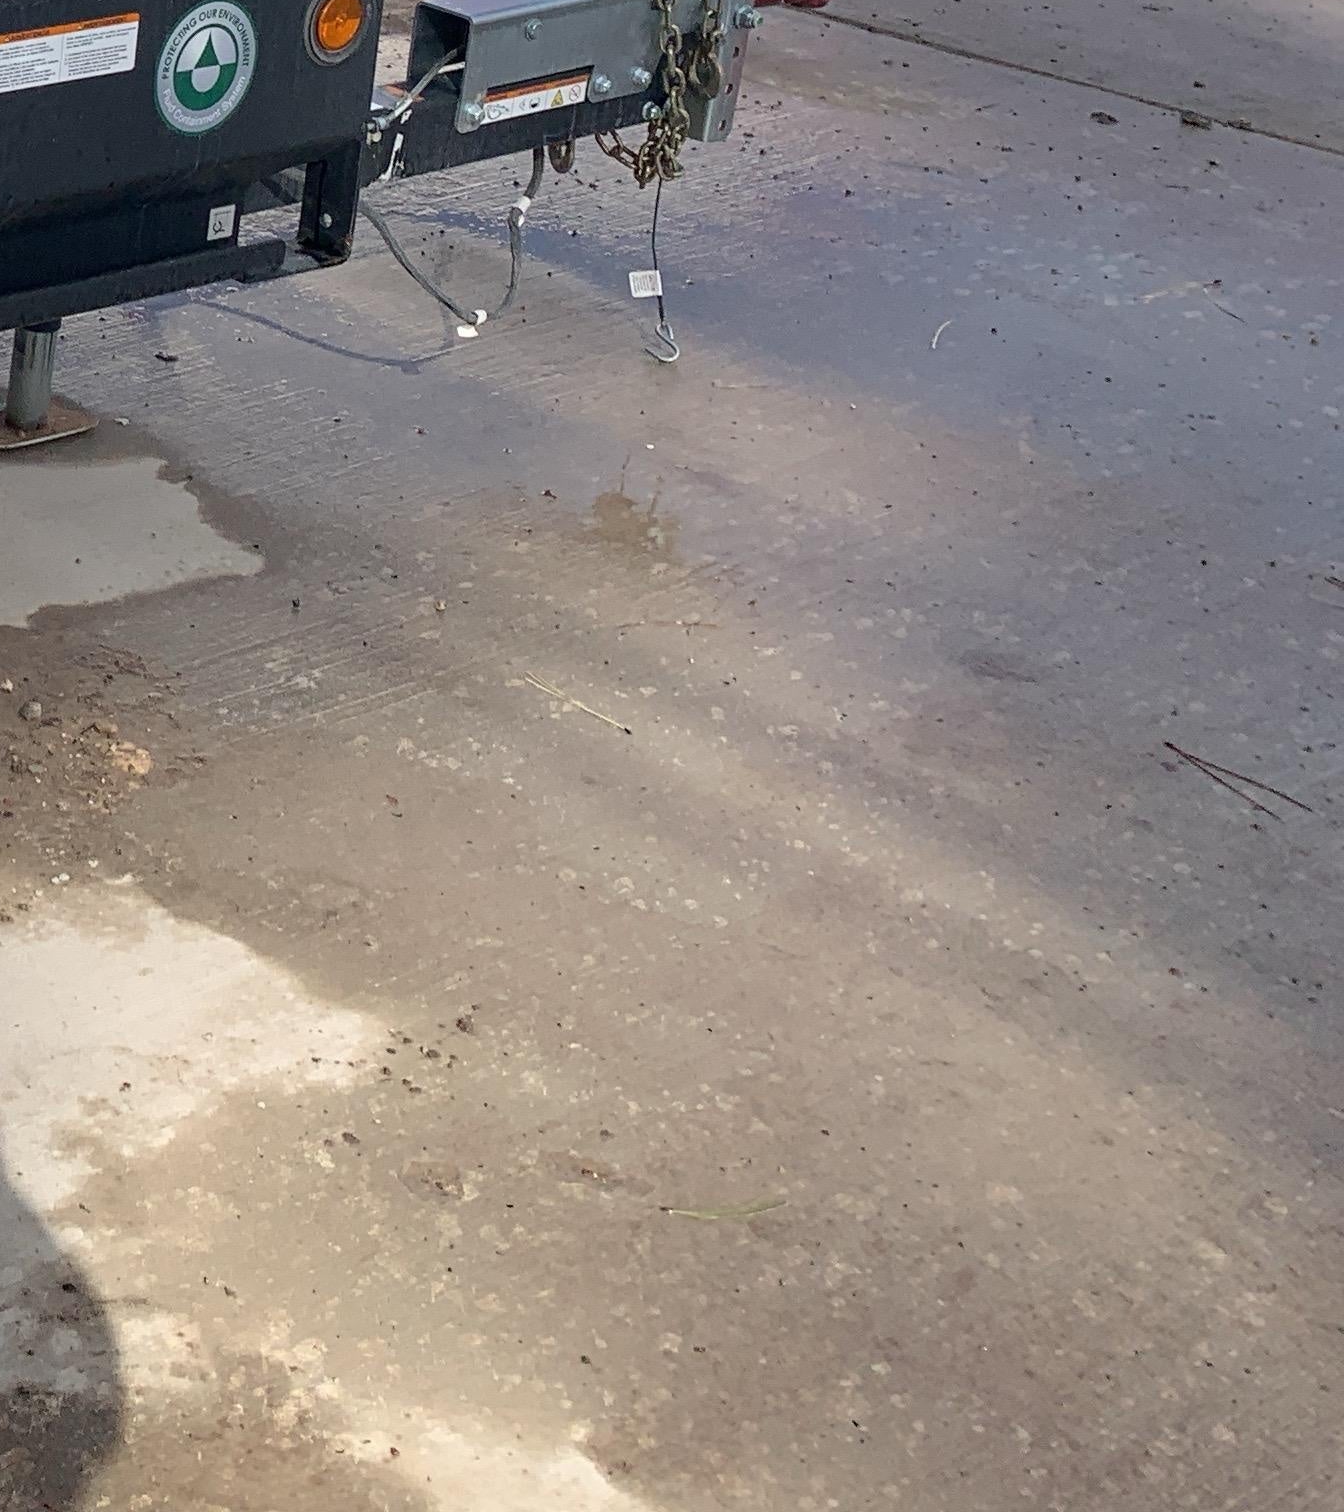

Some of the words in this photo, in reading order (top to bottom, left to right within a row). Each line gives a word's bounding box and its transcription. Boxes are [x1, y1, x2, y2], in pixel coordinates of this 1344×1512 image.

[161, 17, 198, 80] PROTECTING
[198, 8, 218, 22] OUR
[218, 8, 251, 67] ENVIRONMENT
[221, 76, 247, 111] System
